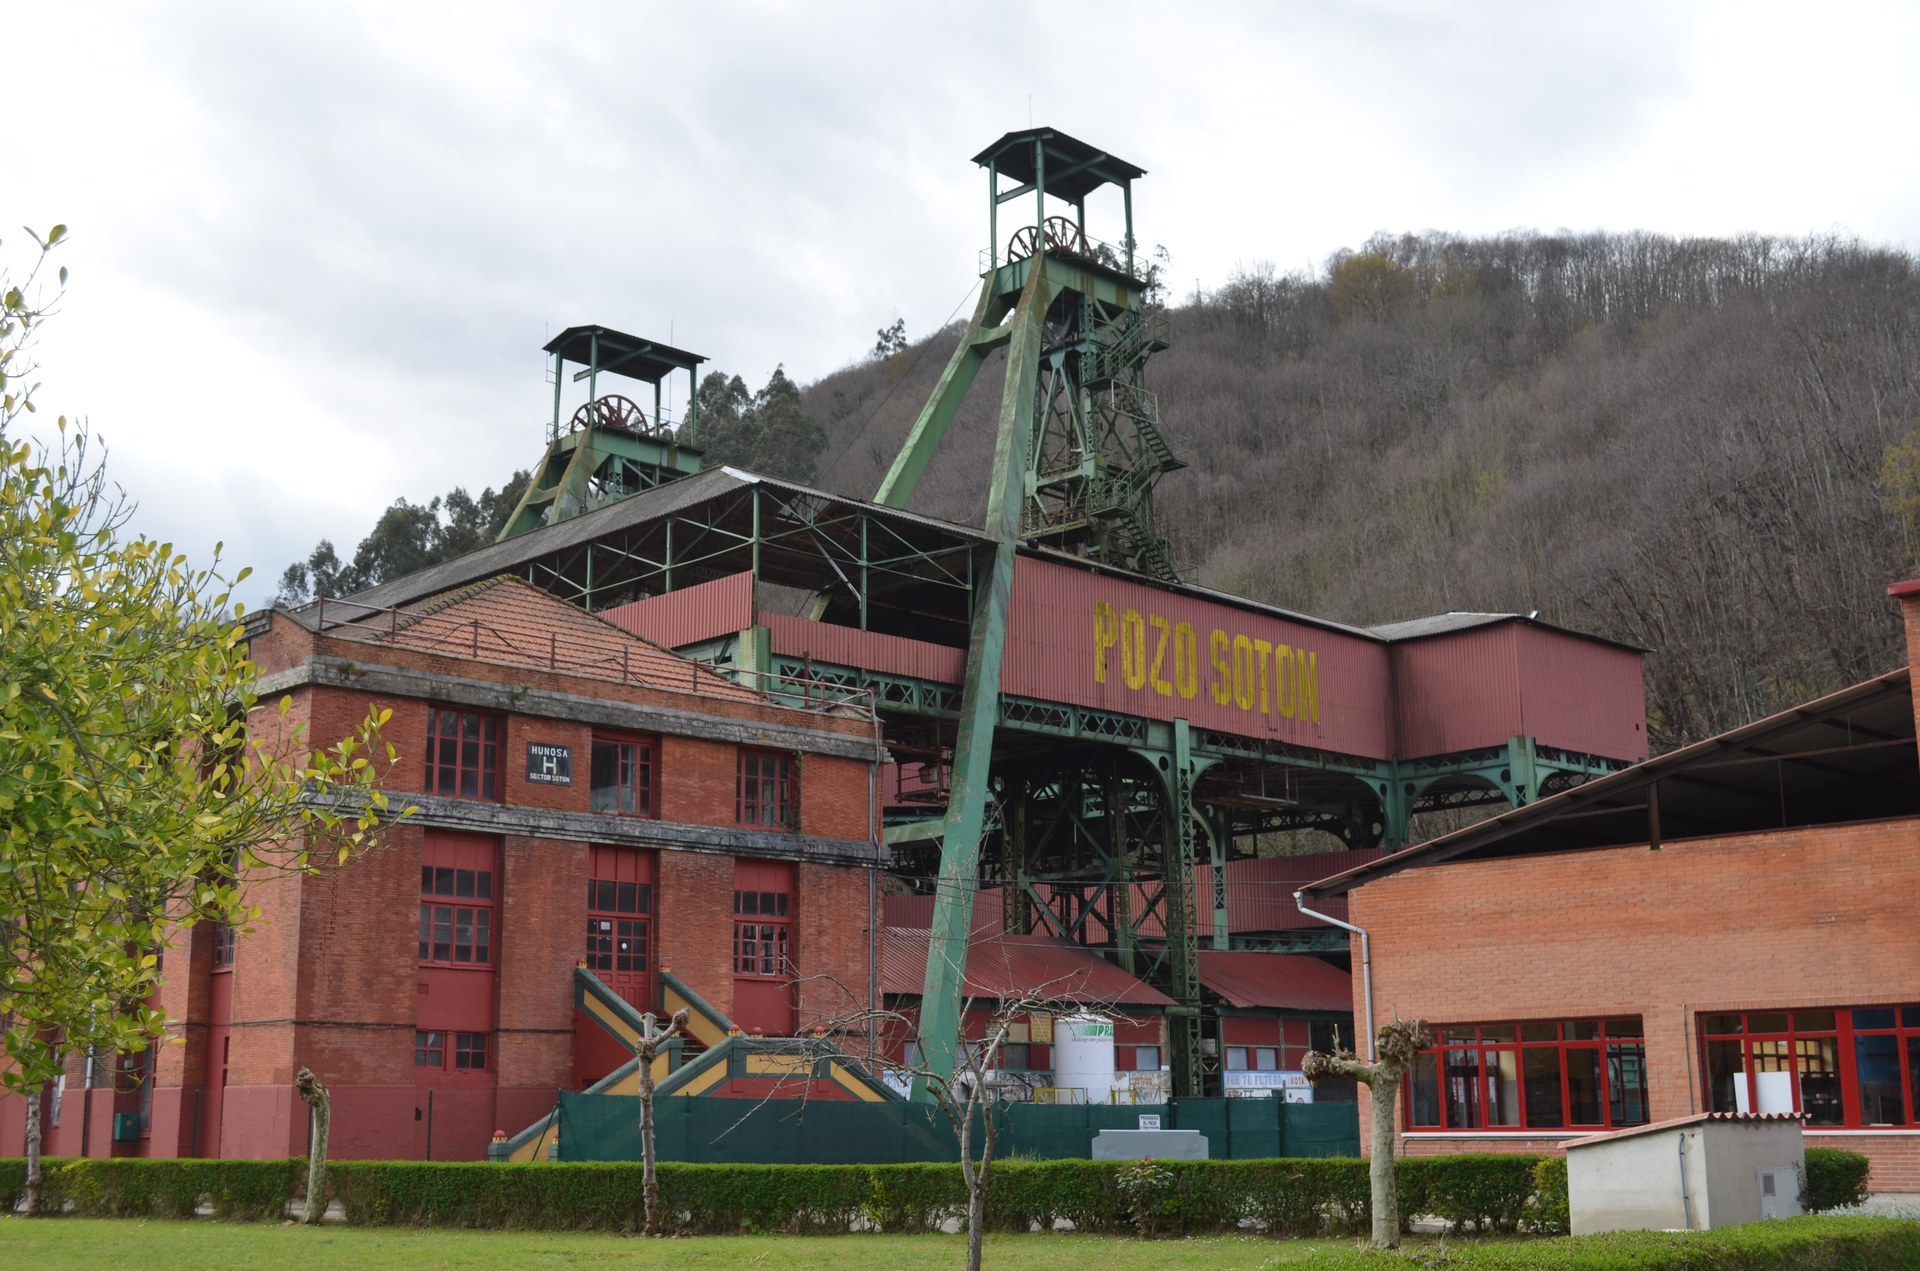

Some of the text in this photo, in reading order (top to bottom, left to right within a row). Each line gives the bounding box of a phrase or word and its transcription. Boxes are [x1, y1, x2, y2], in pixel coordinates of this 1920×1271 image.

[1094, 601, 1320, 725] POZO SOTON
[531, 745, 568, 758] HUNOSA
[543, 756, 557, 774] H
[529, 772, 570, 783] SECTOR SOTON
